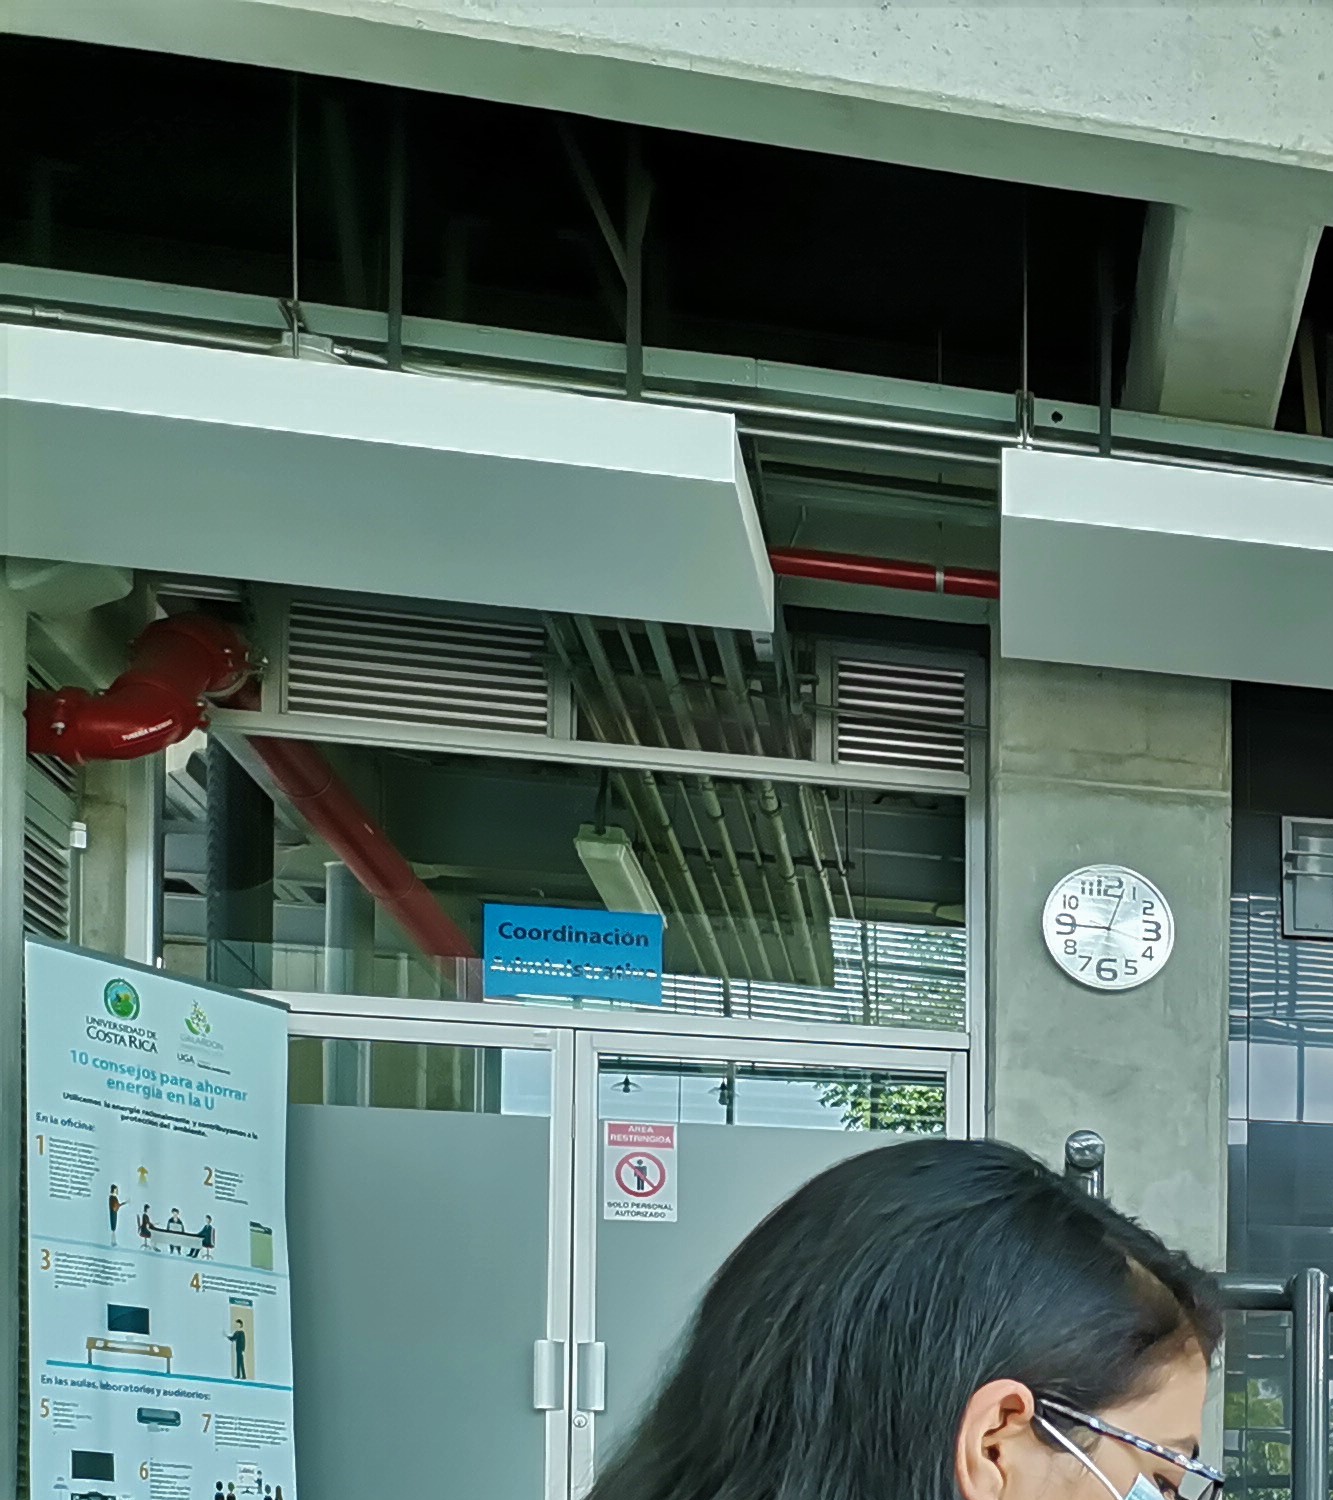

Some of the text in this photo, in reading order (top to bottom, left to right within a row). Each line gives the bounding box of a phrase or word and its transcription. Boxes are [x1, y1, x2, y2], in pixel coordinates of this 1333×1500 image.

[1096, 875, 1124, 899] 12
[1132, 886, 1137, 901] 1
[1063, 894, 1079, 910] 10
[1142, 900, 1155, 916] 2
[498, 921, 649, 947] Coordinación
[1055, 913, 1077, 935] 9
[1142, 919, 1162, 941] 3
[1064, 939, 1077, 955] 8
[1141, 946, 1155, 961] 4
[1078, 955, 1093, 972] 7
[1095, 958, 1118, 982] 6
[1124, 959, 1138, 976] 5
[86, 1016, 157, 1040] UNIVERSIDAD DE
[86, 1025, 128, 1047] COSTA
[128, 1035, 158, 1054] RICA
[70, 1050, 248, 1101] 10 consejos para ahorrar
[167, 1089, 185, 1104] en
[188, 1091, 202, 1109] la
[205, 1098, 215, 1111] U
[36, 1112, 49, 1123] En
[50, 1114, 59, 1125] la
[36, 1134, 44, 1156] 1
[610, 1134, 671, 1144] RESTRINGIDA
[203, 1166, 213, 1187] 2
[607, 1201, 673, 1211] SOLO PERSONAL
[614, 1210, 666, 1219] AUTORIZADO
[40, 1248, 51, 1271] 3
[190, 1272, 201, 1293] 4
[40, 1374, 53, 1385] En
[54, 1376, 68, 1386] las
[99, 1380, 155, 1395] laboratorios
[155, 1387, 161, 1397] y
[39, 1398, 50, 1419] 5
[201, 1413, 212, 1434] 7
[139, 1461, 149, 1480] 6
